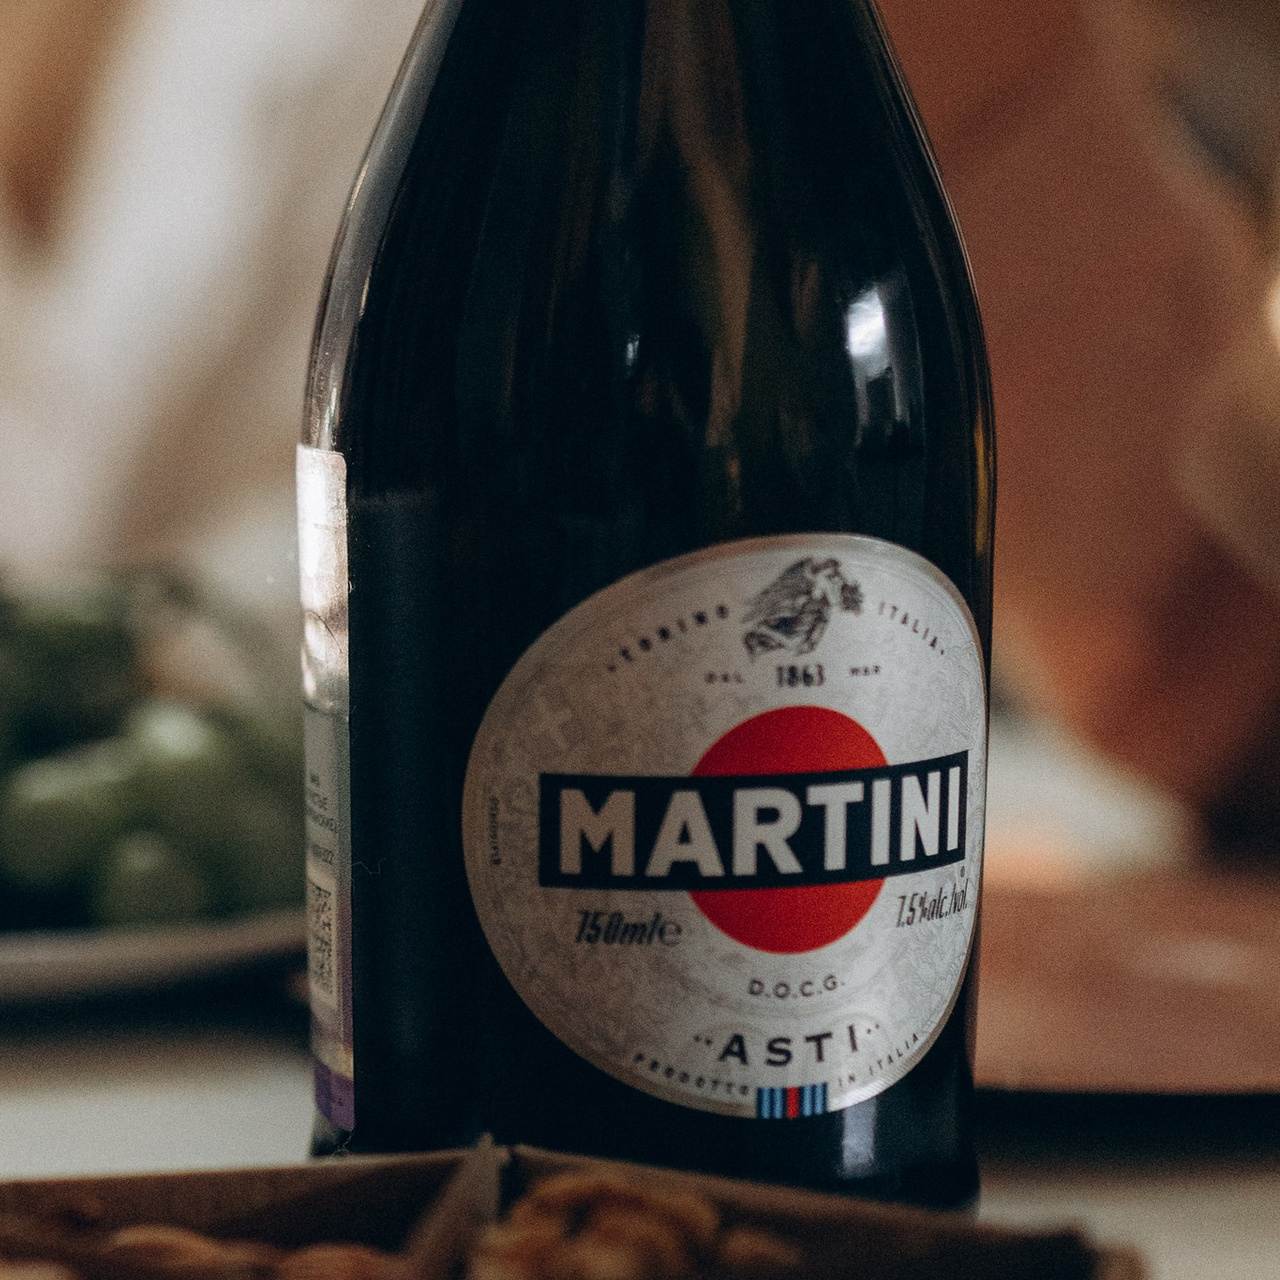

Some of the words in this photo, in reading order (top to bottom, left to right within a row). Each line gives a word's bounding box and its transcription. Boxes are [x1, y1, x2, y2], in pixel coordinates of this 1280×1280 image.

[878, 599, 939, 649] ITALIA
[776, 663, 825, 688] 1863
[559, 766, 961, 878] MARTINI
[747, 974, 846, 999] D.O.C.G.
[719, 1023, 858, 1067] ASTI
[869, 1032, 919, 1077] ITALIA
